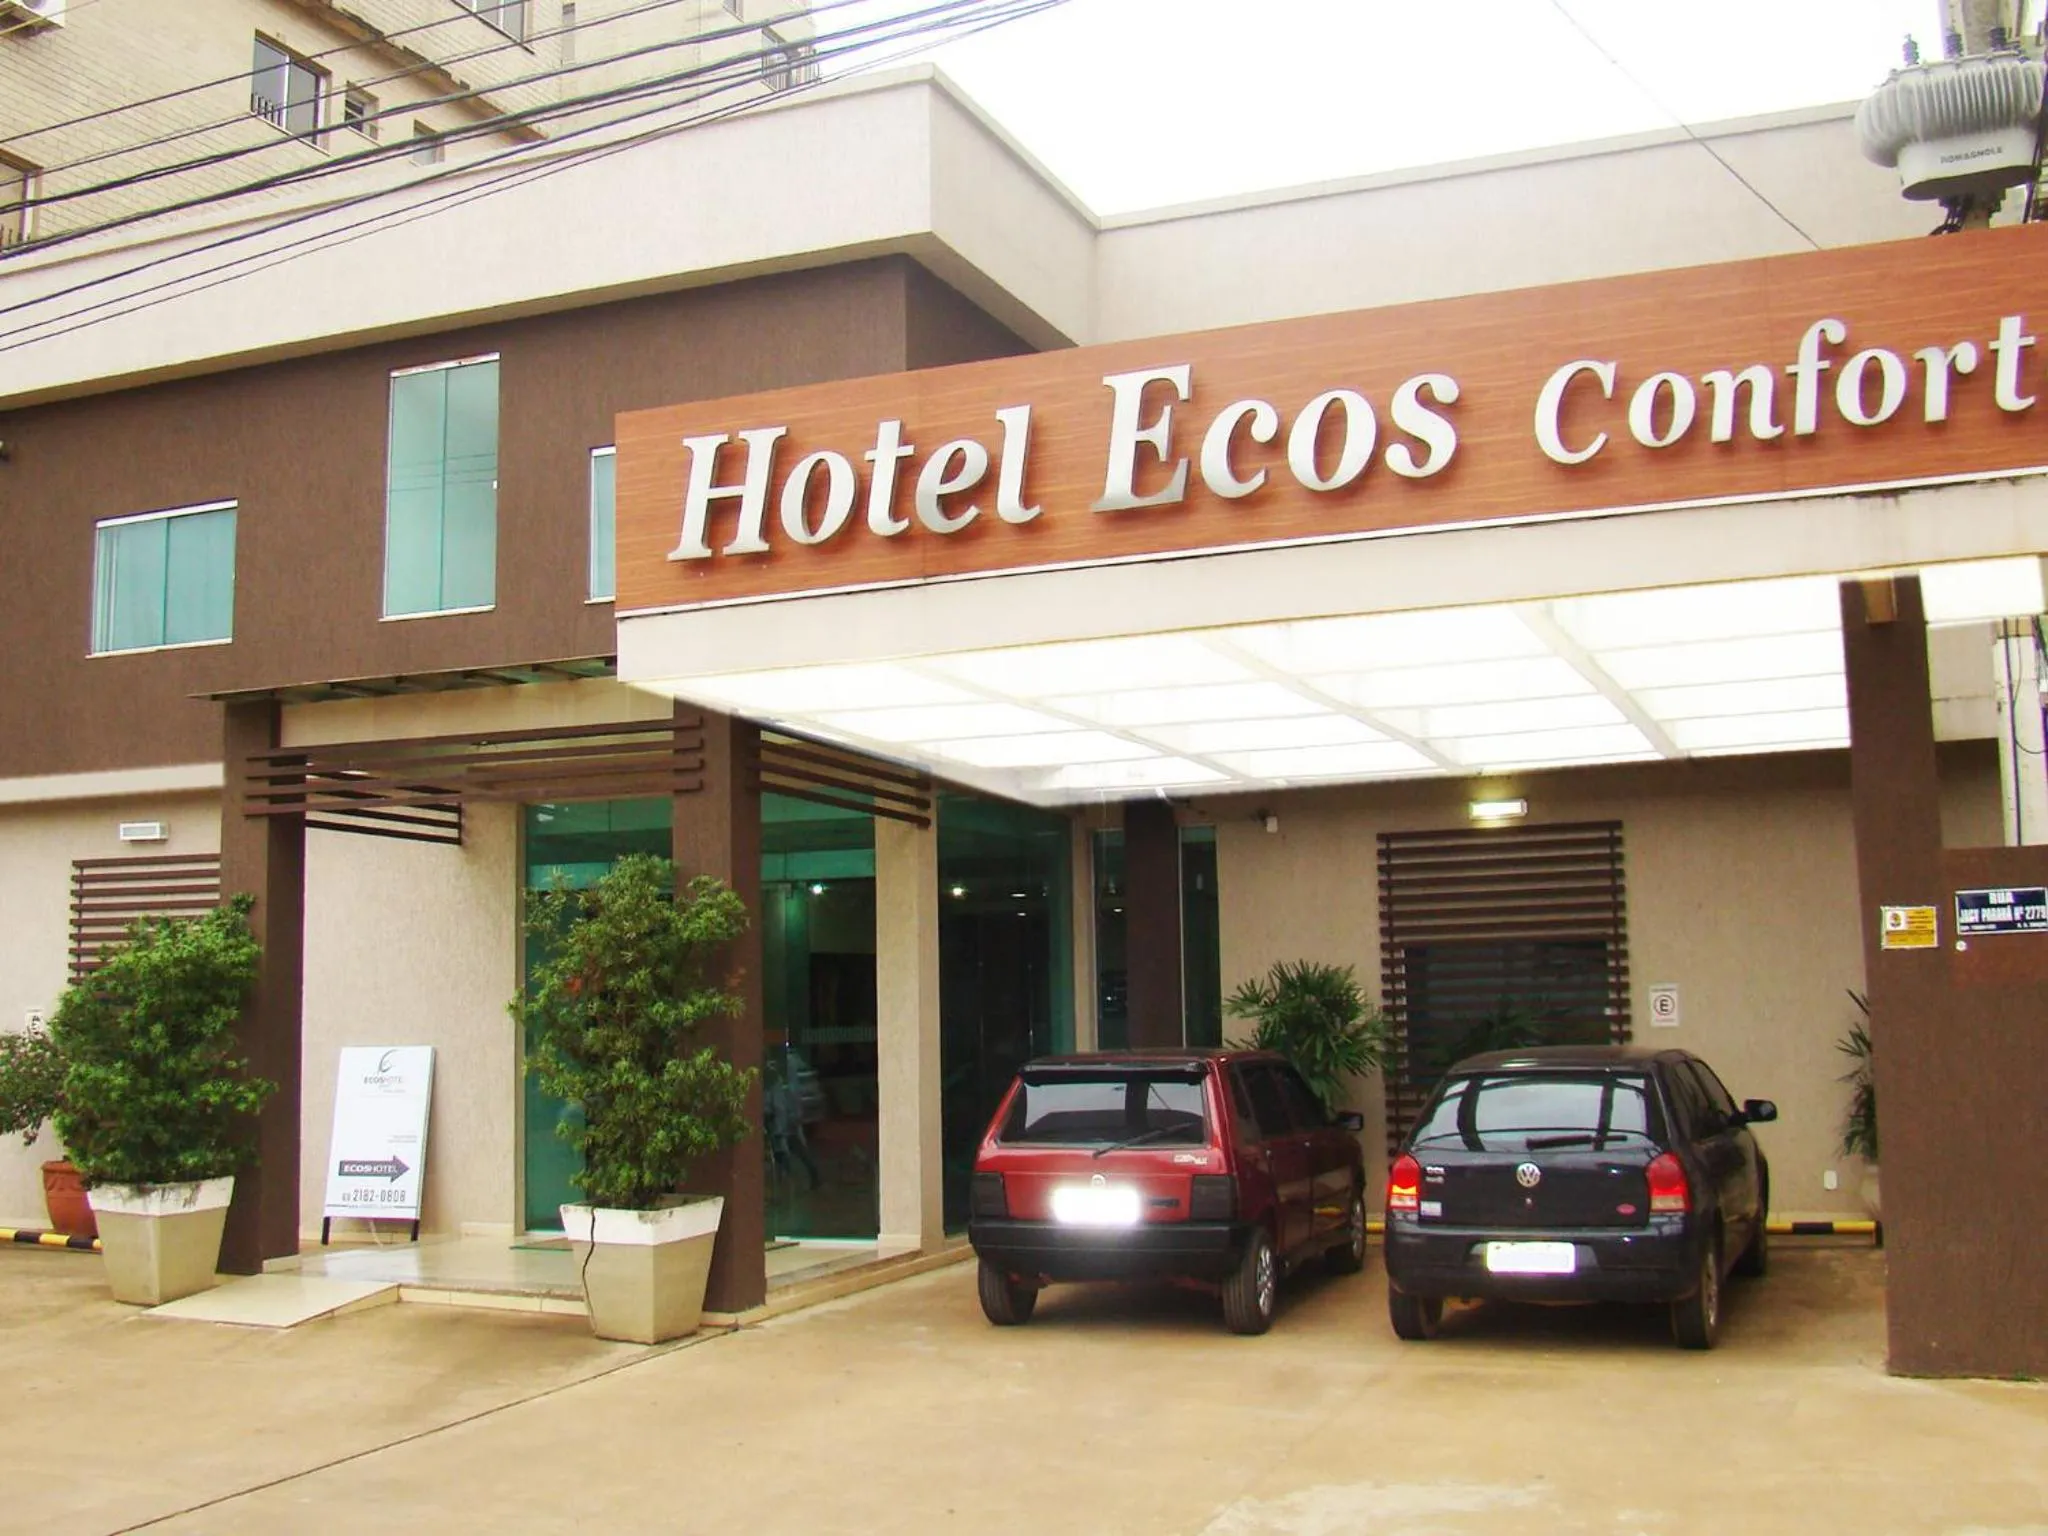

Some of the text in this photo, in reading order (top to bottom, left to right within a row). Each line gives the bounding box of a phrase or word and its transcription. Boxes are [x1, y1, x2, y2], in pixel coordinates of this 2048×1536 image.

[668, 316, 2037, 561] Hotel Ecos Confort
[1989, 892, 2015, 904] RUA
[1660, 999, 1669, 1012] E
